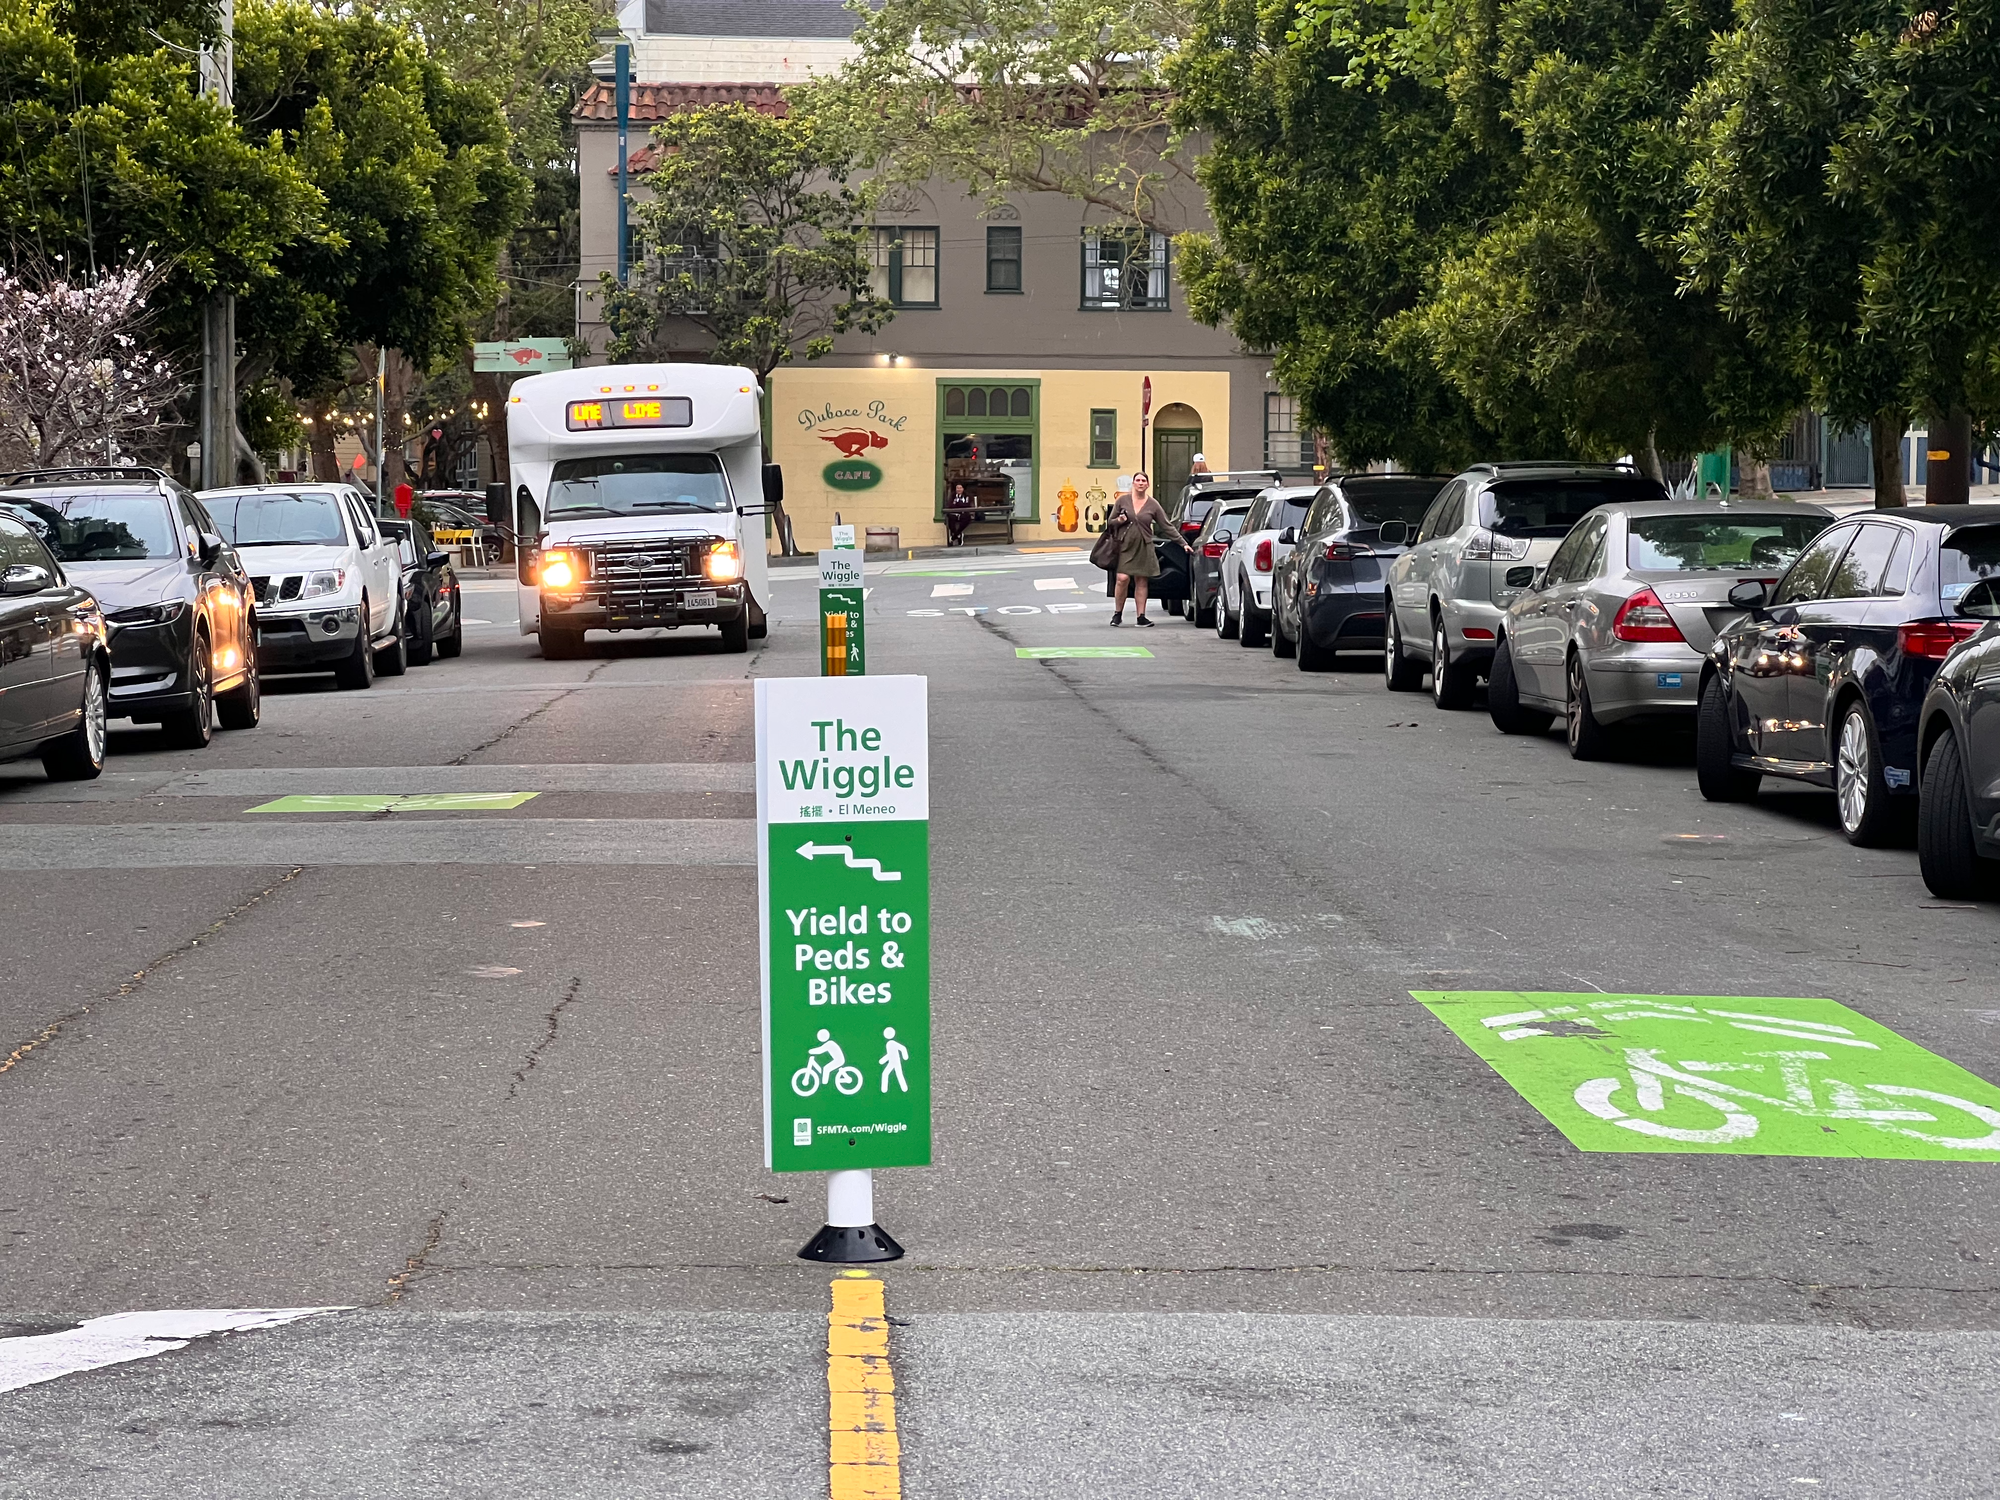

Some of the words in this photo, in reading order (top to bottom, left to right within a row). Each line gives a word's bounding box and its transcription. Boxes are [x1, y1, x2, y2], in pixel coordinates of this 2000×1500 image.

[797, 402, 862, 432] Duboce
[866, 400, 908, 432] Park
[834, 471, 871, 480] CAFE
[830, 561, 851, 570] The
[822, 570, 860, 582] Wiggle
[850, 611, 860, 619] to
[906, 603, 1087, 617] STOP
[811, 719, 882, 752] The
[779, 756, 915, 798] Wiggle
[838, 803, 849, 815] El
[853, 804, 897, 815] Meneo
[785, 905, 868, 937] Yield
[877, 908, 912, 935] to
[794, 942, 871, 972] Peds
[880, 941, 905, 970] &
[808, 978, 892, 1007] Bikes
[816, 1122, 908, 1135] SFMTA.com/Wiggle
